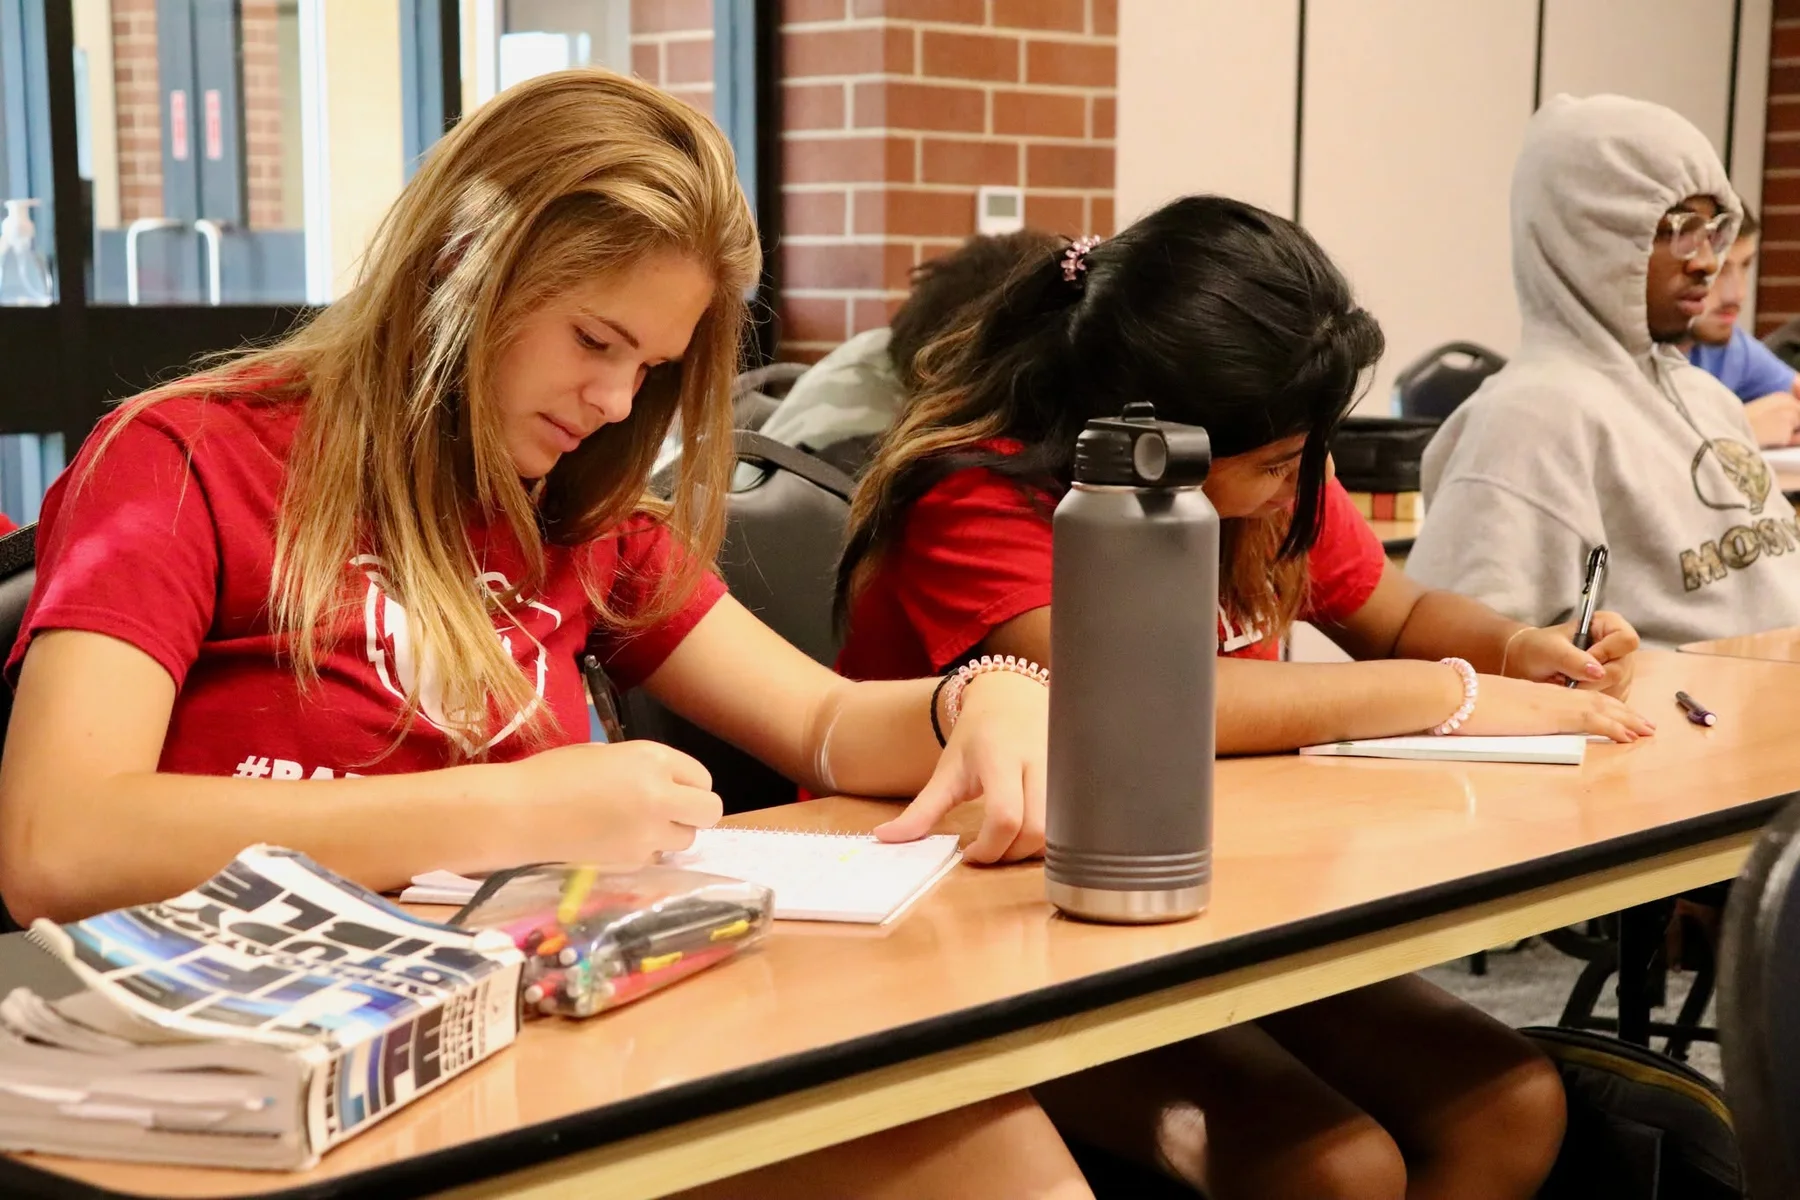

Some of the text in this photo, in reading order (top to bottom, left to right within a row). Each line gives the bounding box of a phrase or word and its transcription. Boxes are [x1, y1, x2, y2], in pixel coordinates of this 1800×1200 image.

[79, 907, 421, 1026] LIFE
[162, 902, 464, 987] STUDY
[196, 860, 488, 971] BIBLE
[339, 1005, 445, 1132] LIFE
